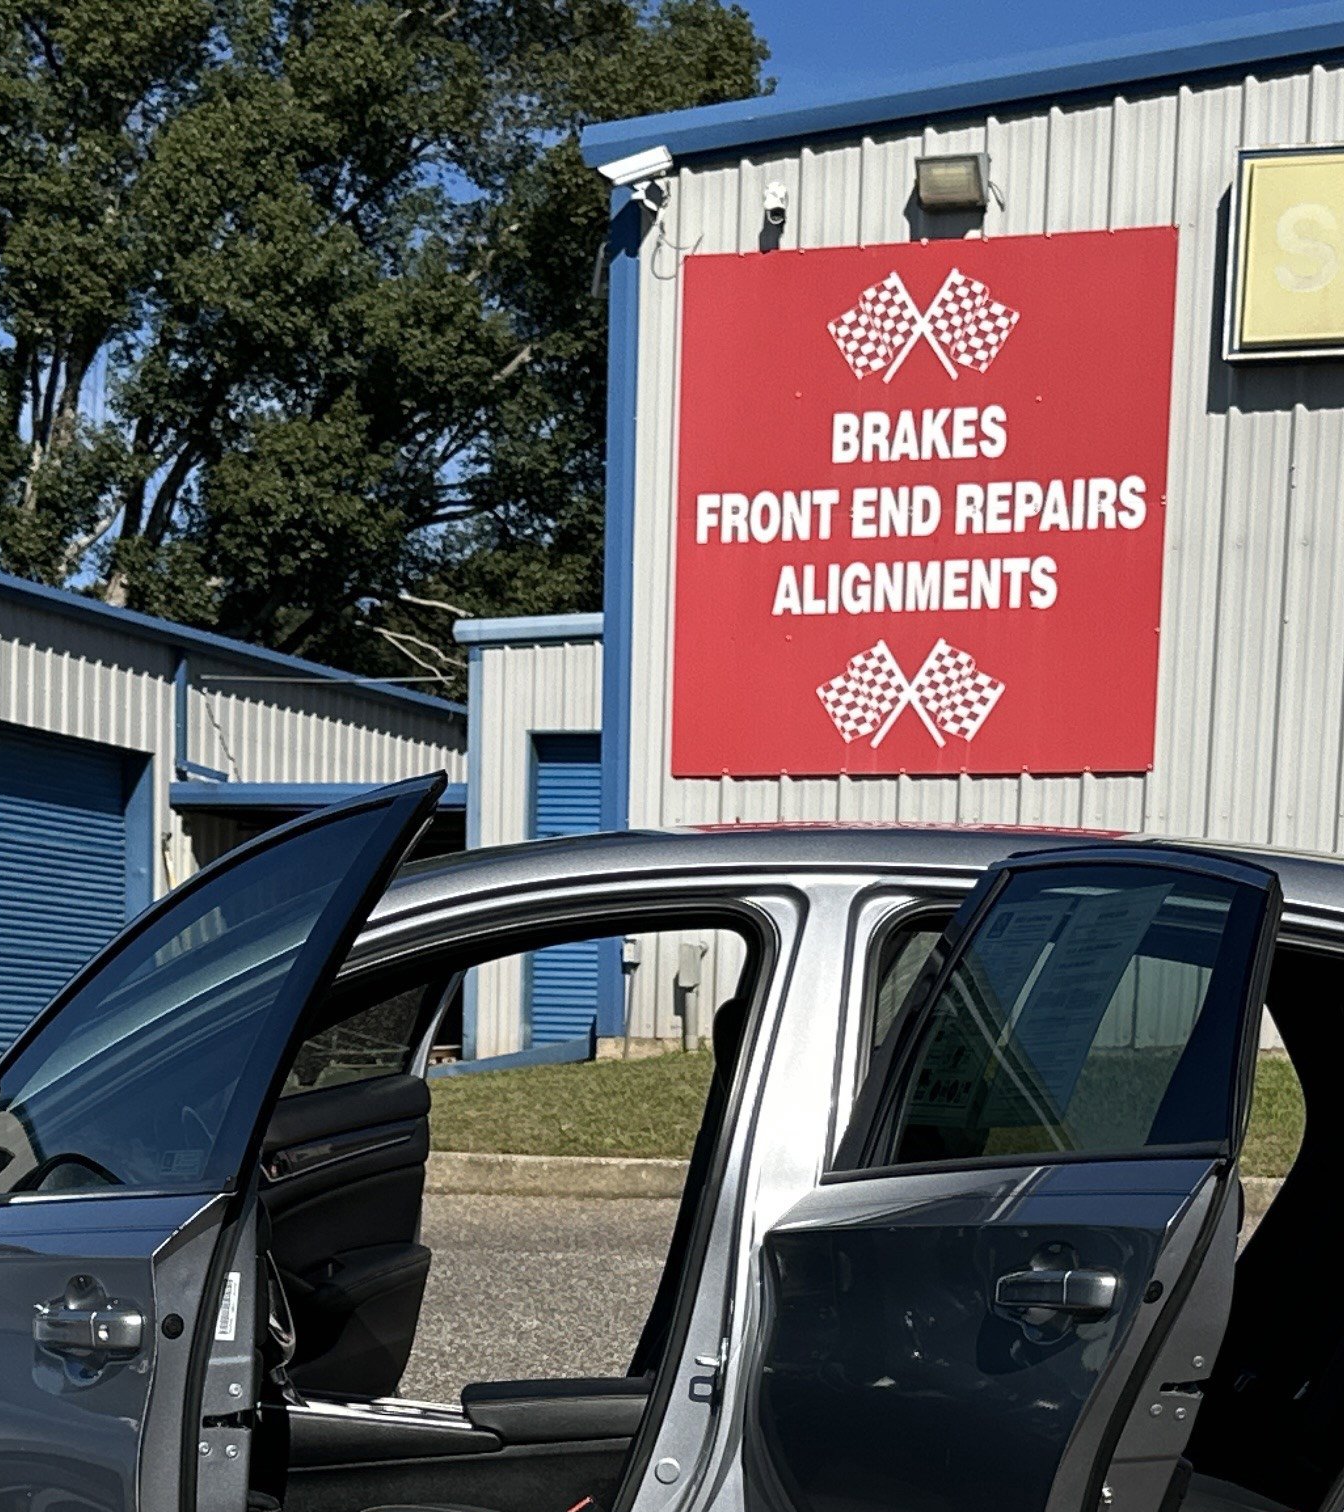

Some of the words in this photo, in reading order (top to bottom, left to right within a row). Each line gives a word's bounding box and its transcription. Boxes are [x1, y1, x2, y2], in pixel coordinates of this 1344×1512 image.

[831, 405, 1008, 464] BRAKES
[695, 488, 841, 544] FRONT
[850, 485, 942, 539] END
[954, 475, 1147, 535] REPAIRS
[771, 555, 1059, 616] ALIGNMENTS
